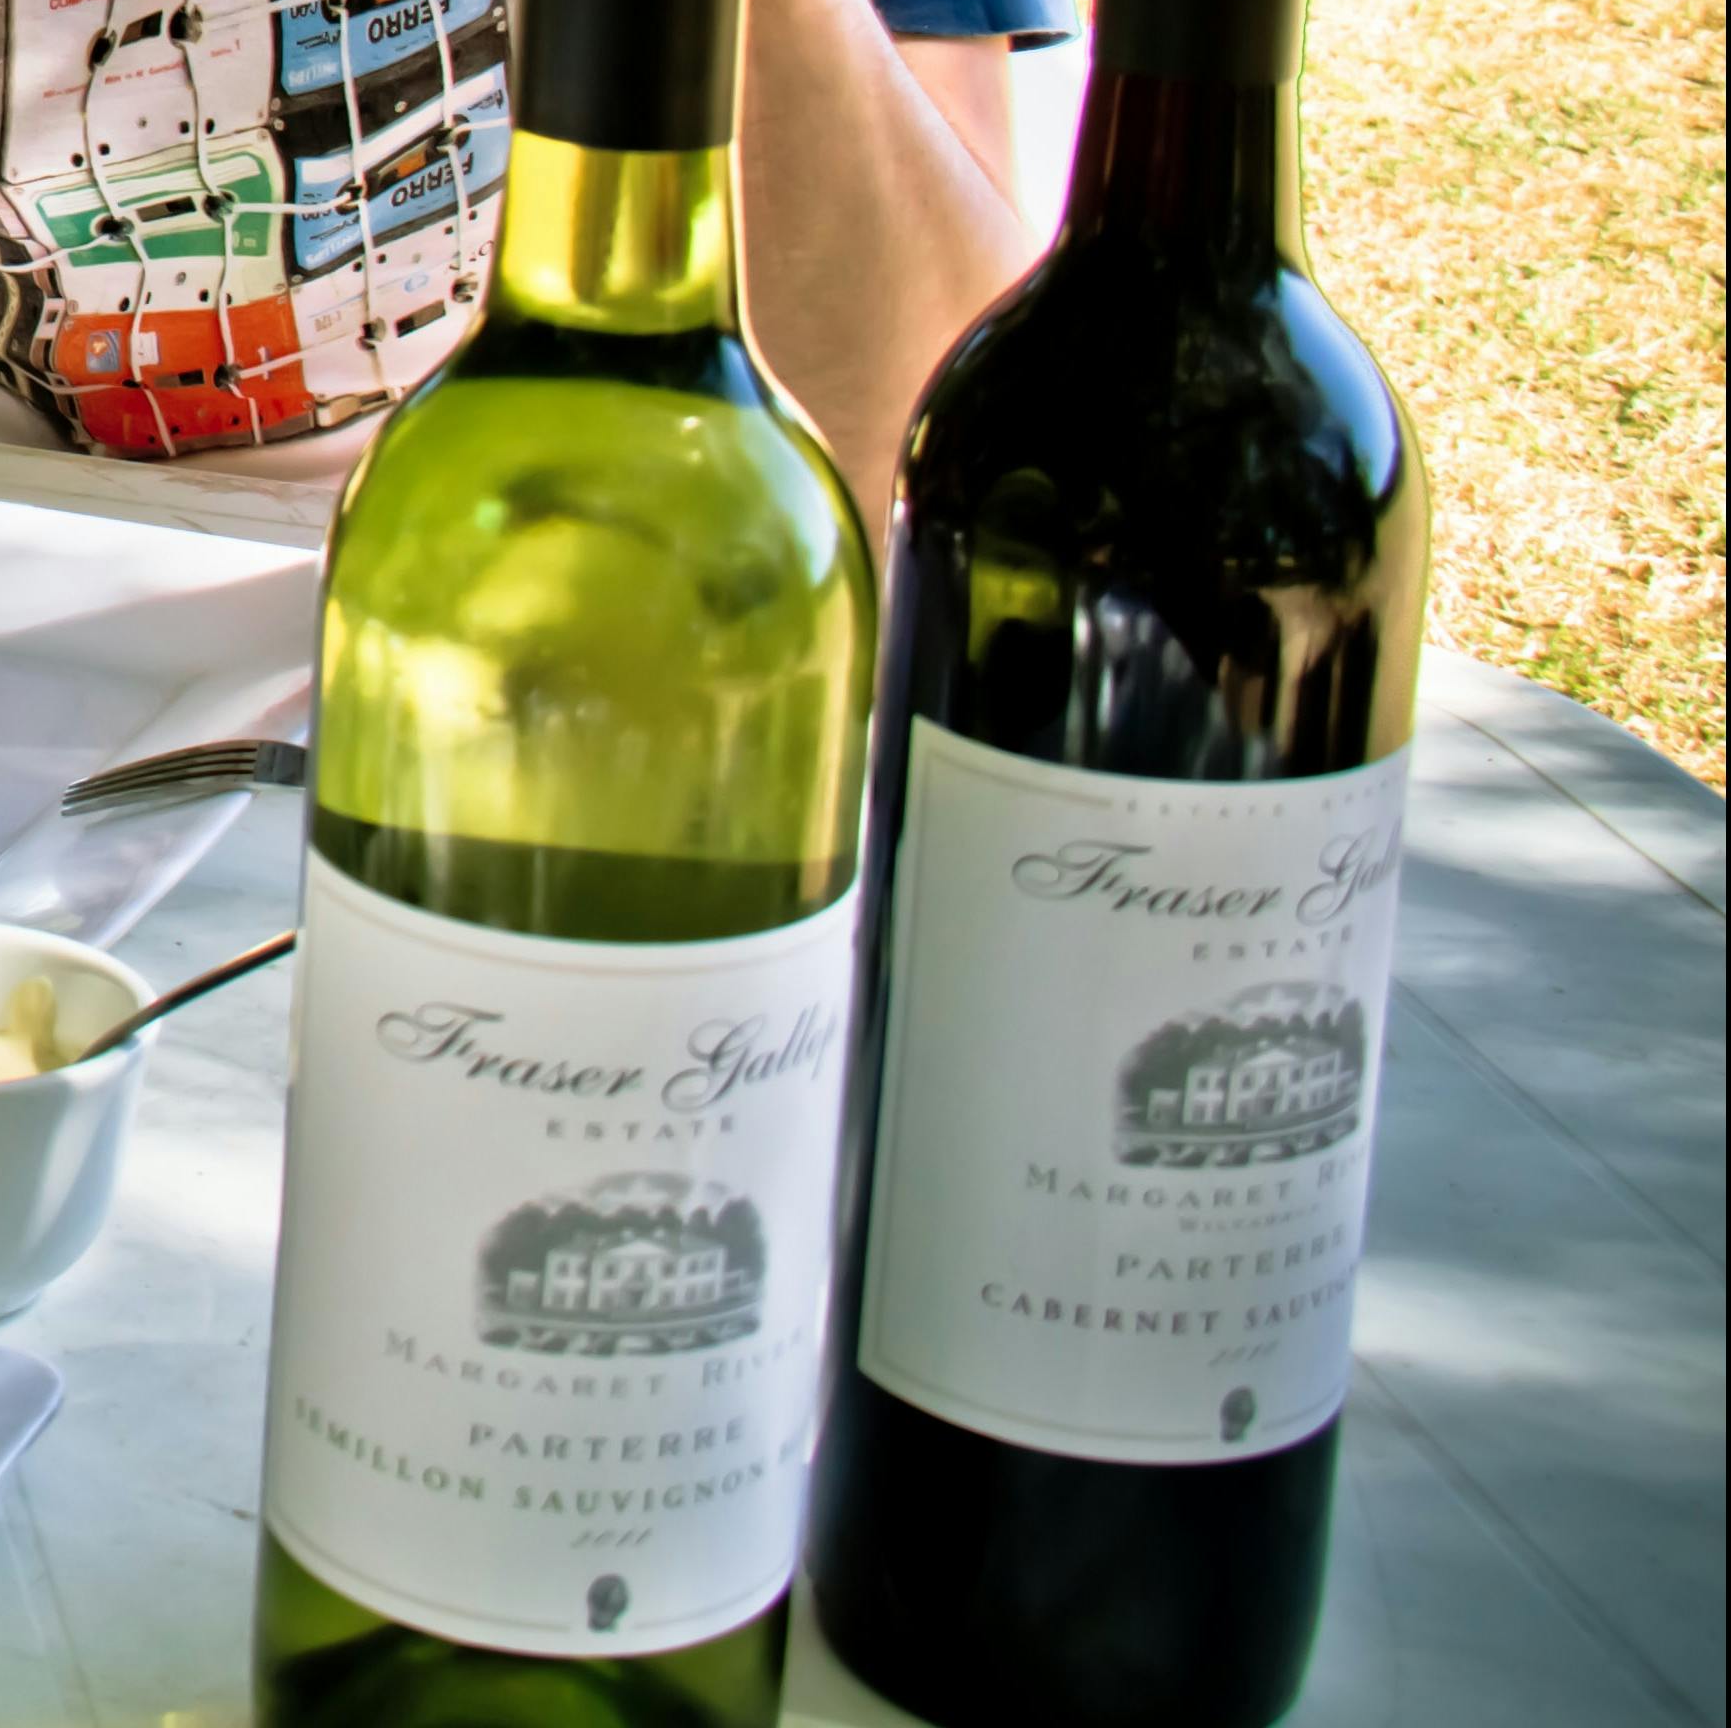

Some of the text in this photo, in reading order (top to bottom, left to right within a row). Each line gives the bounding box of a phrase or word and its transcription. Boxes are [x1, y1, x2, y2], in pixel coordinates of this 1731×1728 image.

[1011, 839, 1282, 919] Fraser
[1192, 926, 1355, 963] ESTATE
[375, 1000, 644, 1099] Fraser
[546, 1114, 734, 1141] ESTATE
[1024, 1163, 1295, 1210] MARGARET
[1115, 1222, 1348, 1282] PARTERRE
[980, 1281, 1223, 1336] CABERNET
[383, 1329, 666, 1400] MARGARET
[469, 1416, 746, 1462] PARTERRE
[513, 1461, 765, 1516] SAUVIGNON
